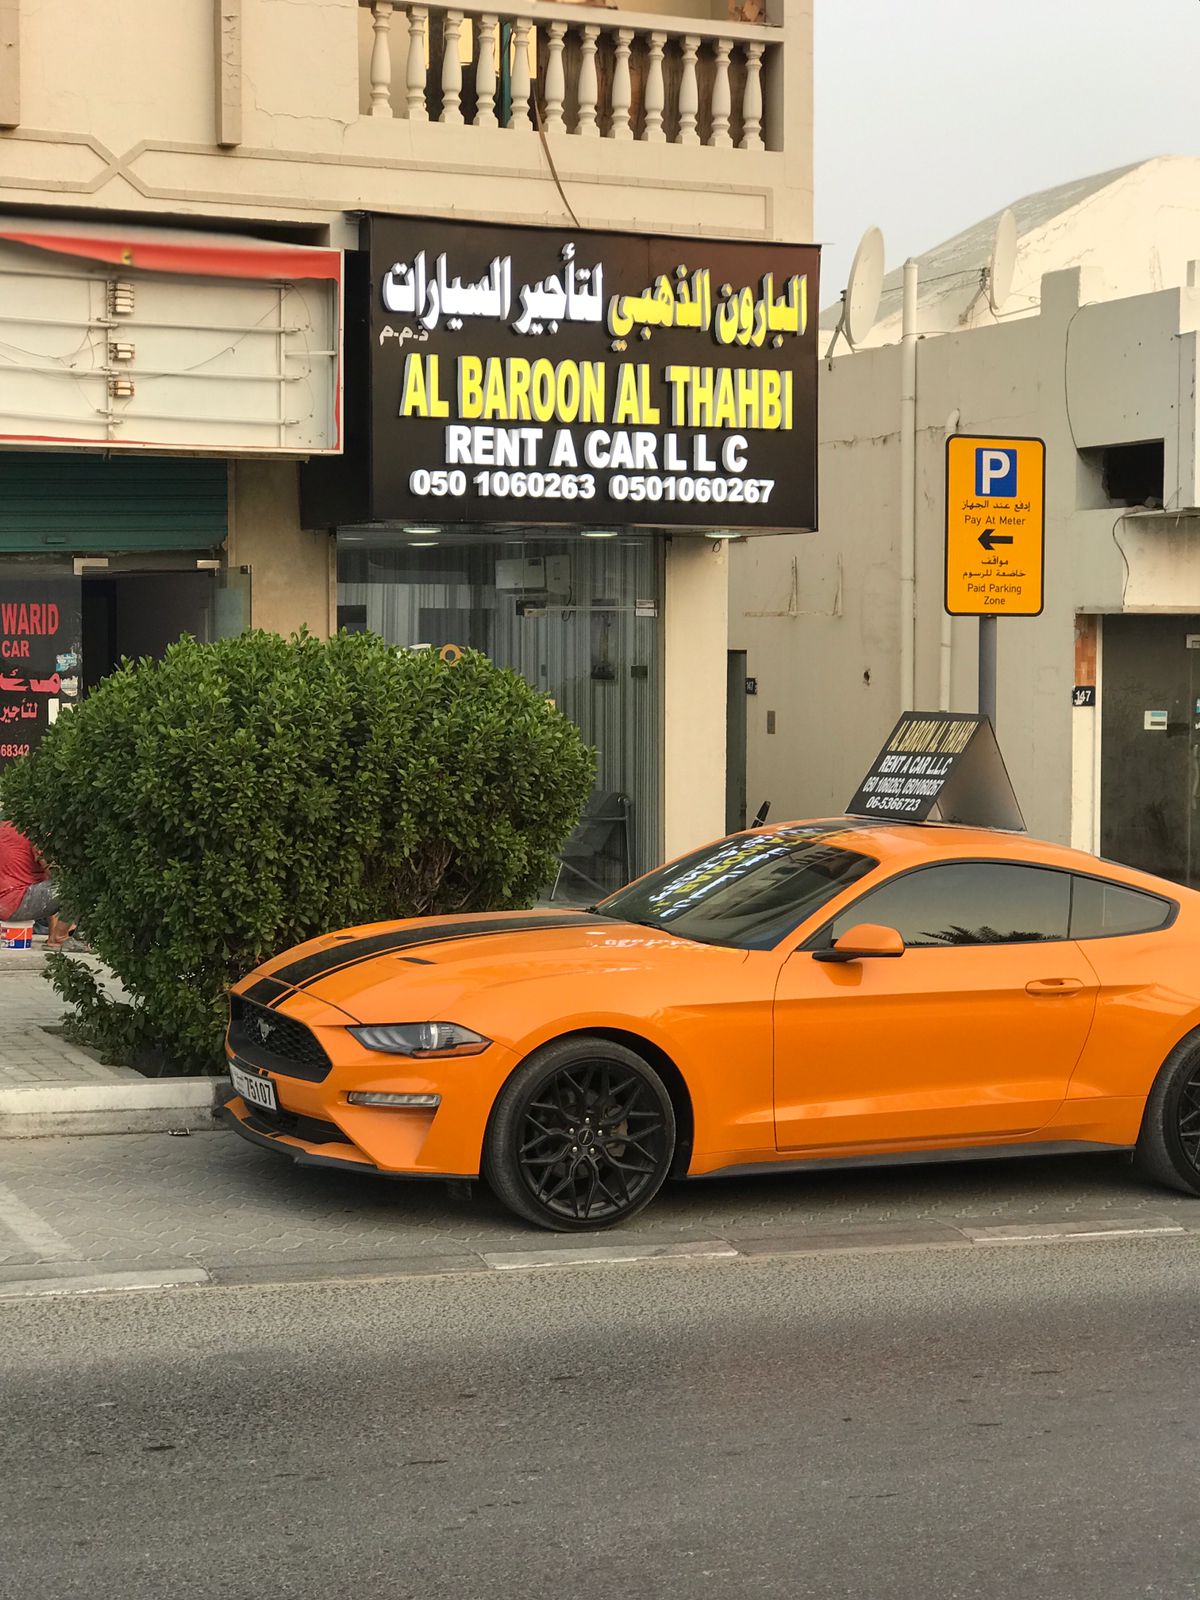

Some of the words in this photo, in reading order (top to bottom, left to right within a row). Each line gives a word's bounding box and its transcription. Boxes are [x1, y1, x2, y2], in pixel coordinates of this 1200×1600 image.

[382, 250, 512, 331] السيارات
[512, 242, 603, 334] لتأجير
[607, 264, 711, 352] الذهبي
[715, 272, 808, 348] البارون
[399, 353, 450, 418] AL
[457, 355, 606, 424] BAROON
[612, 362, 660, 425] AL
[665, 365, 793, 430] THAHBI
[445, 425, 543, 467] RENT
[549, 428, 578, 468] A
[584, 429, 659, 470] CAR
[409, 469, 467, 497] 050
[472, 471, 596, 500] 1060263
[608, 474, 775, 504] 0501060267
[981, 450, 1011, 495] P
[964, 514, 981, 527] Pay
[986, 515, 995, 525] At
[999, 516, 1025, 526] Meter
[962, 568, 993, 581] للرسوم
[981, 555, 1009, 568] مواقف
[996, 568, 1026, 578] خاضعة
[967, 583, 986, 593] Paid
[989, 583, 1022, 596] Parking
[983, 595, 1006, 606] Zone
[1, 602, 60, 636] WARID
[1, 639, 31, 658] CAR
[1075, 689, 1092, 703] 147
[886, 720, 911, 752] AL
[878, 755, 907, 773] RENT
[899, 755, 914, 774] A
[908, 756, 932, 775] CAR
[865, 795, 922, 812] 06-5366723
[244, 1075, 272, 1106] 75107
